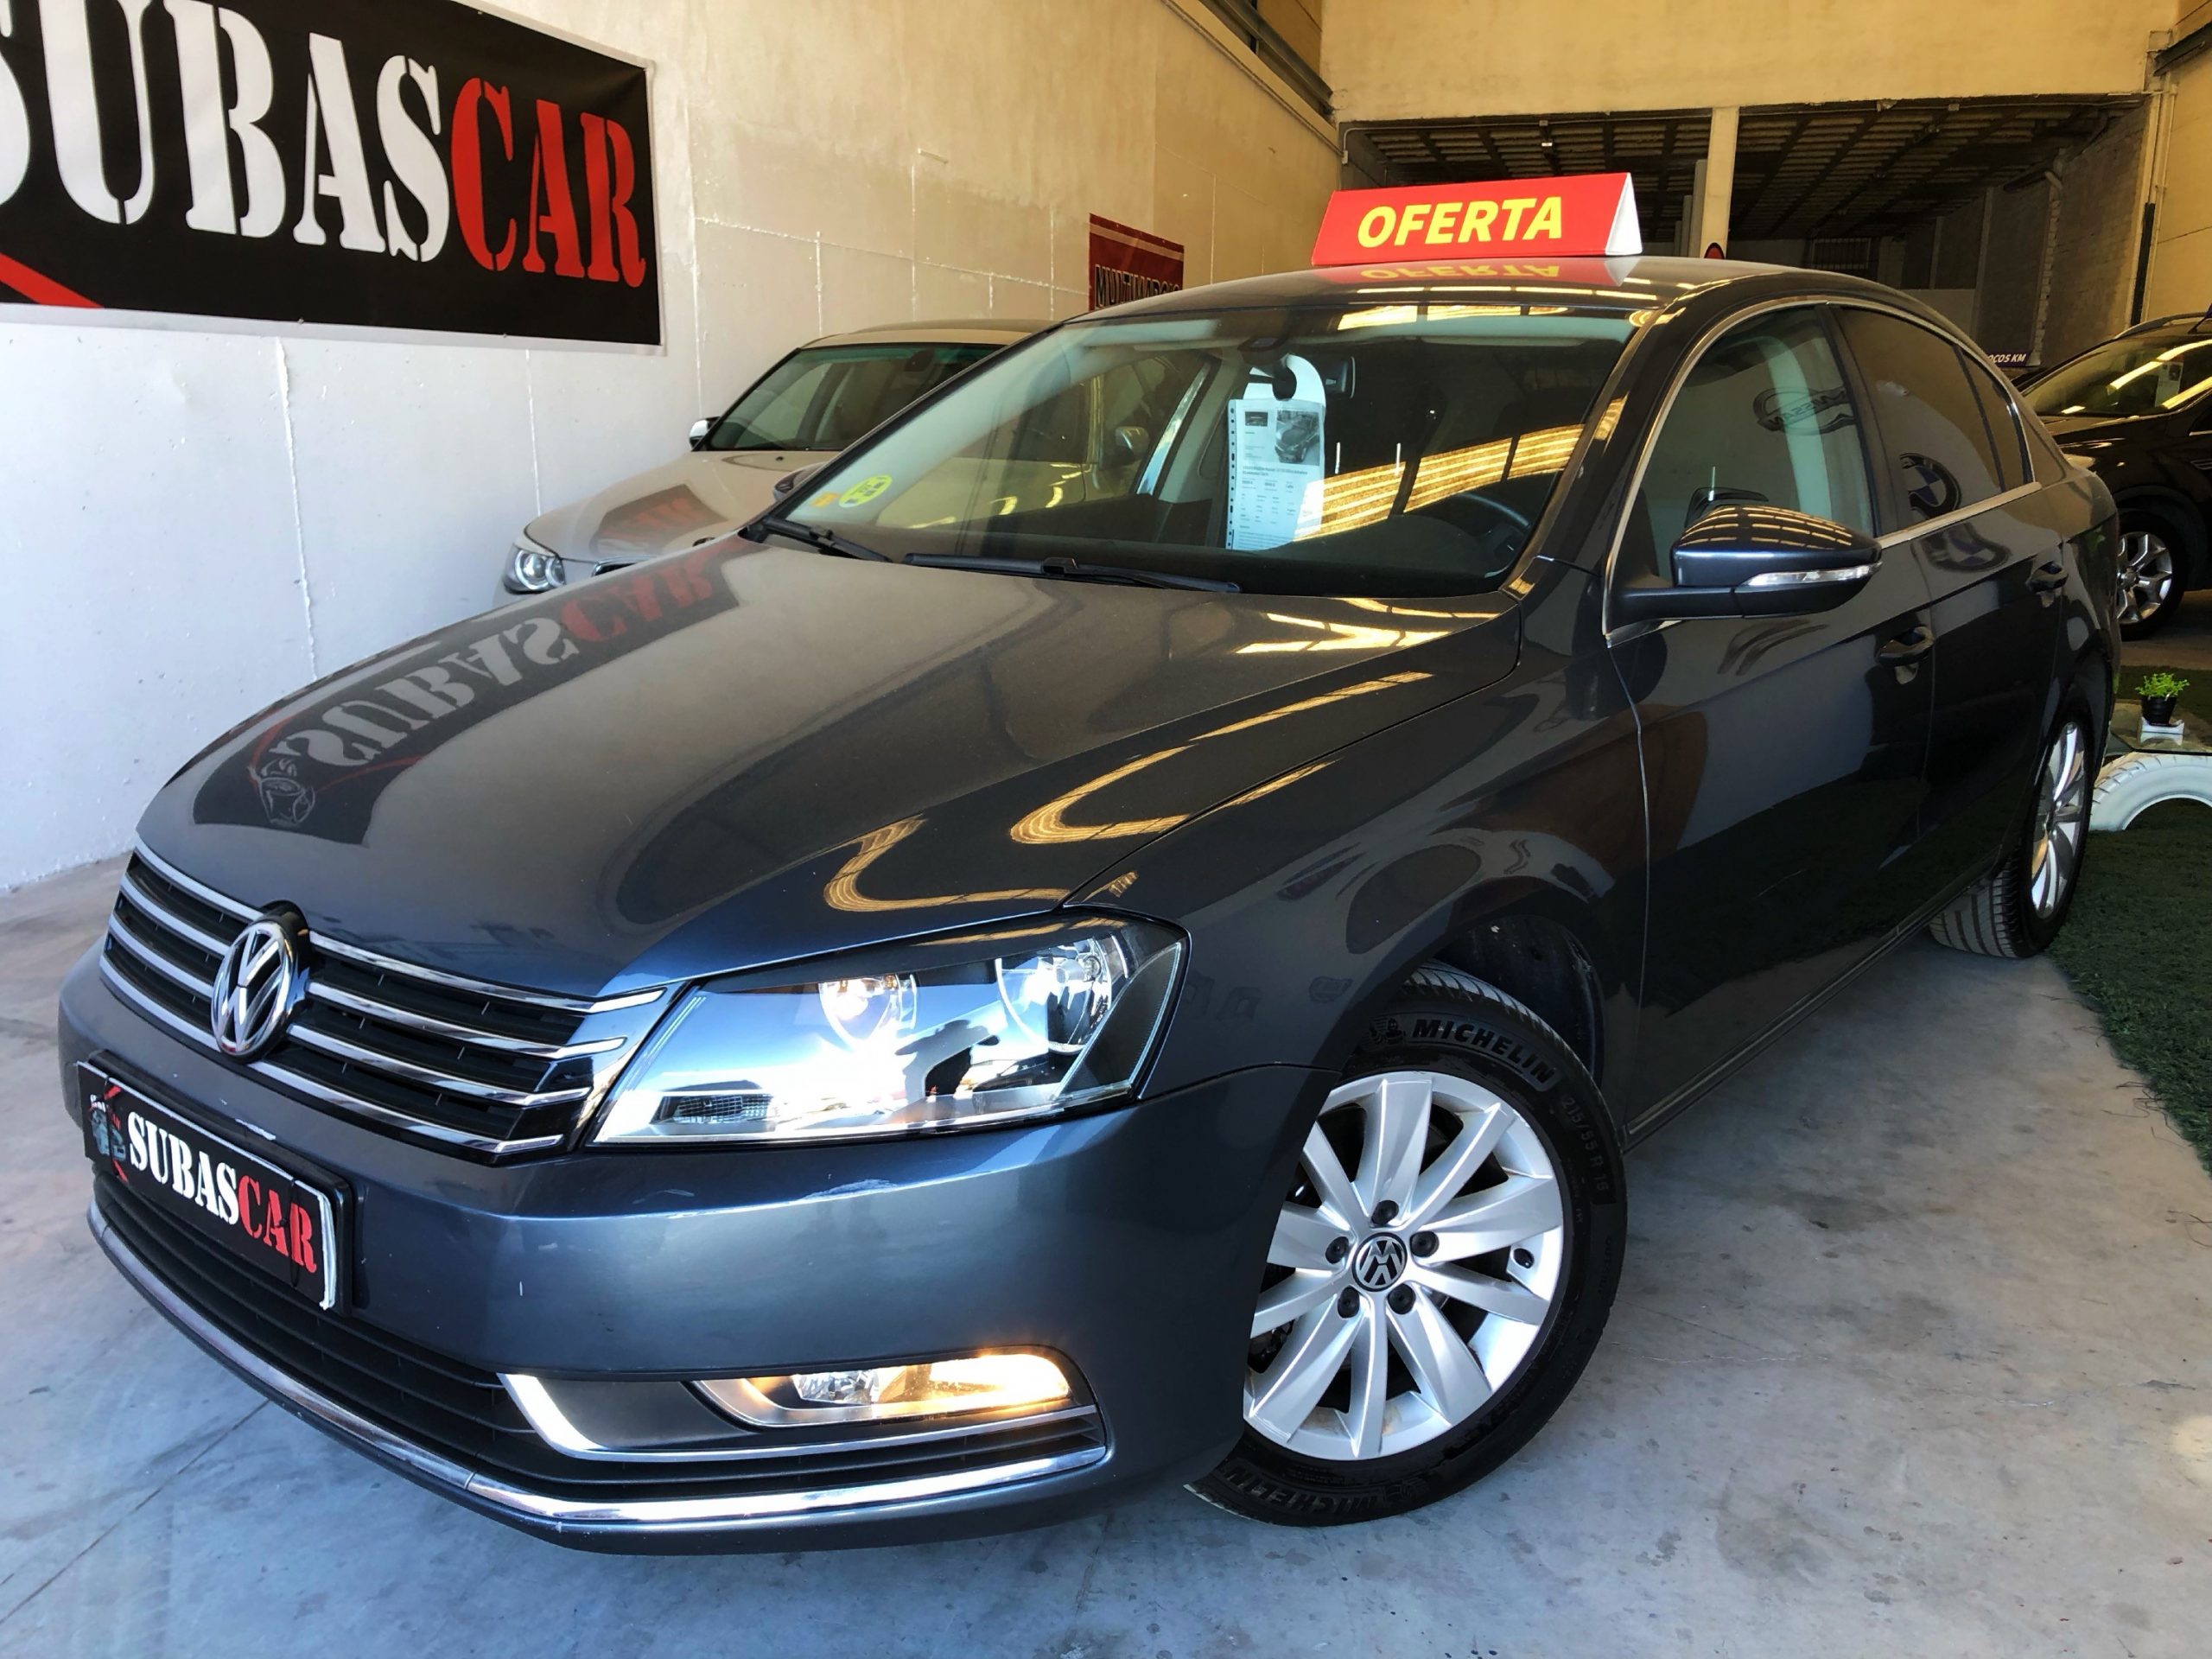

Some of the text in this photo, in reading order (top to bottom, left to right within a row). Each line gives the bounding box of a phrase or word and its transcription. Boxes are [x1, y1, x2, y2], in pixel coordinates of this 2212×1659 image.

[1357, 196, 1562, 248] OFERTA
[1094, 264, 1180, 309] MULTIMA
[2011, 353, 2027, 362] KM
[211, 922, 293, 1056] VW
[1412, 1017, 1563, 1084] MICHELIN
[1562, 1096, 1597, 1151] 215/55
[1594, 1173, 1609, 1191] 16
[128, 1111, 317, 1273] SUBASCAR
[1355, 1235, 1405, 1289] VW
[1223, 1466, 1378, 1516] MICHELIN
